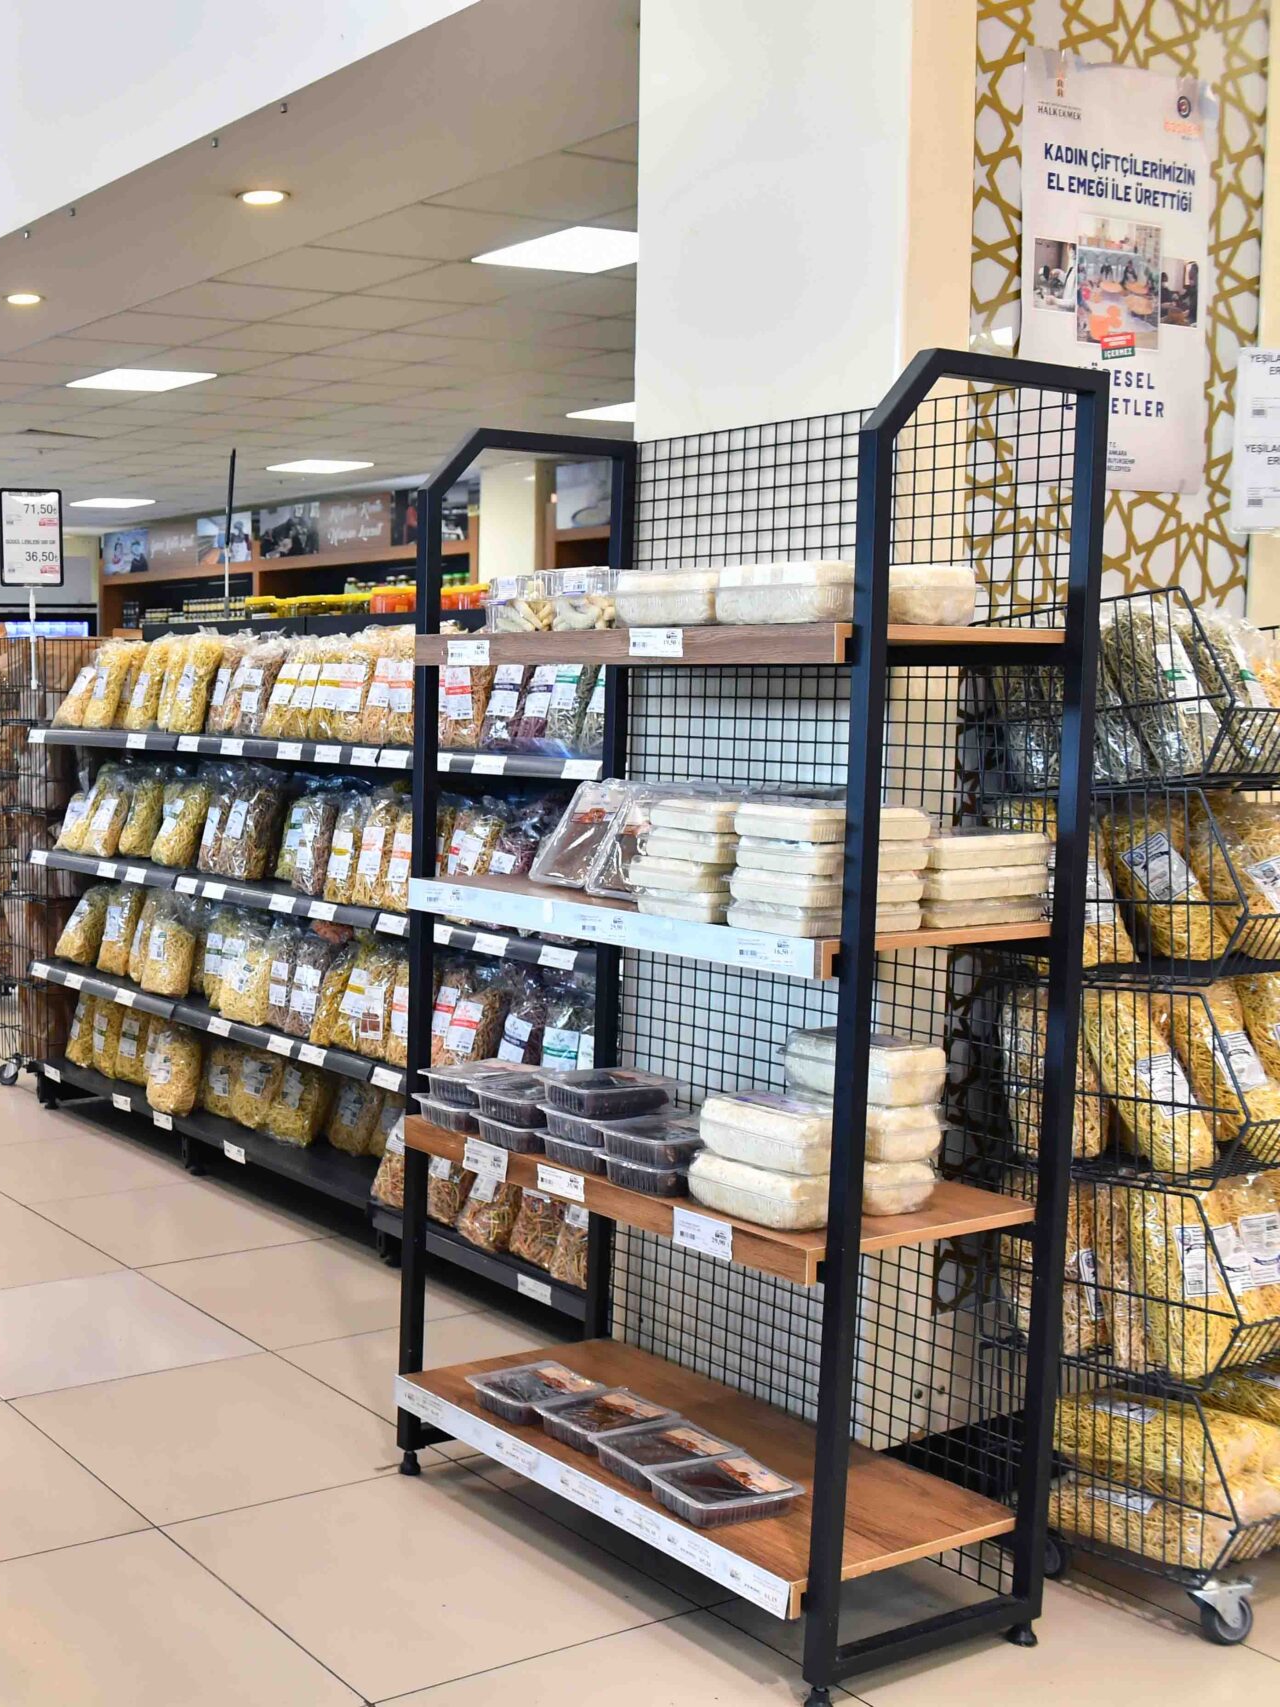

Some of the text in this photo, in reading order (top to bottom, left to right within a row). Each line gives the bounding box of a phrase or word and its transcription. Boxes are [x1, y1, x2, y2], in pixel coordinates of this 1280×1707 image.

[1044, 142, 1196, 186] KADIN ÇİFTÇİLERİMİZİN
[1047, 172, 1193, 213] EL EMEĞİ İLE ÜRETTİĞİ
[1065, 393, 1165, 418] LETLER
